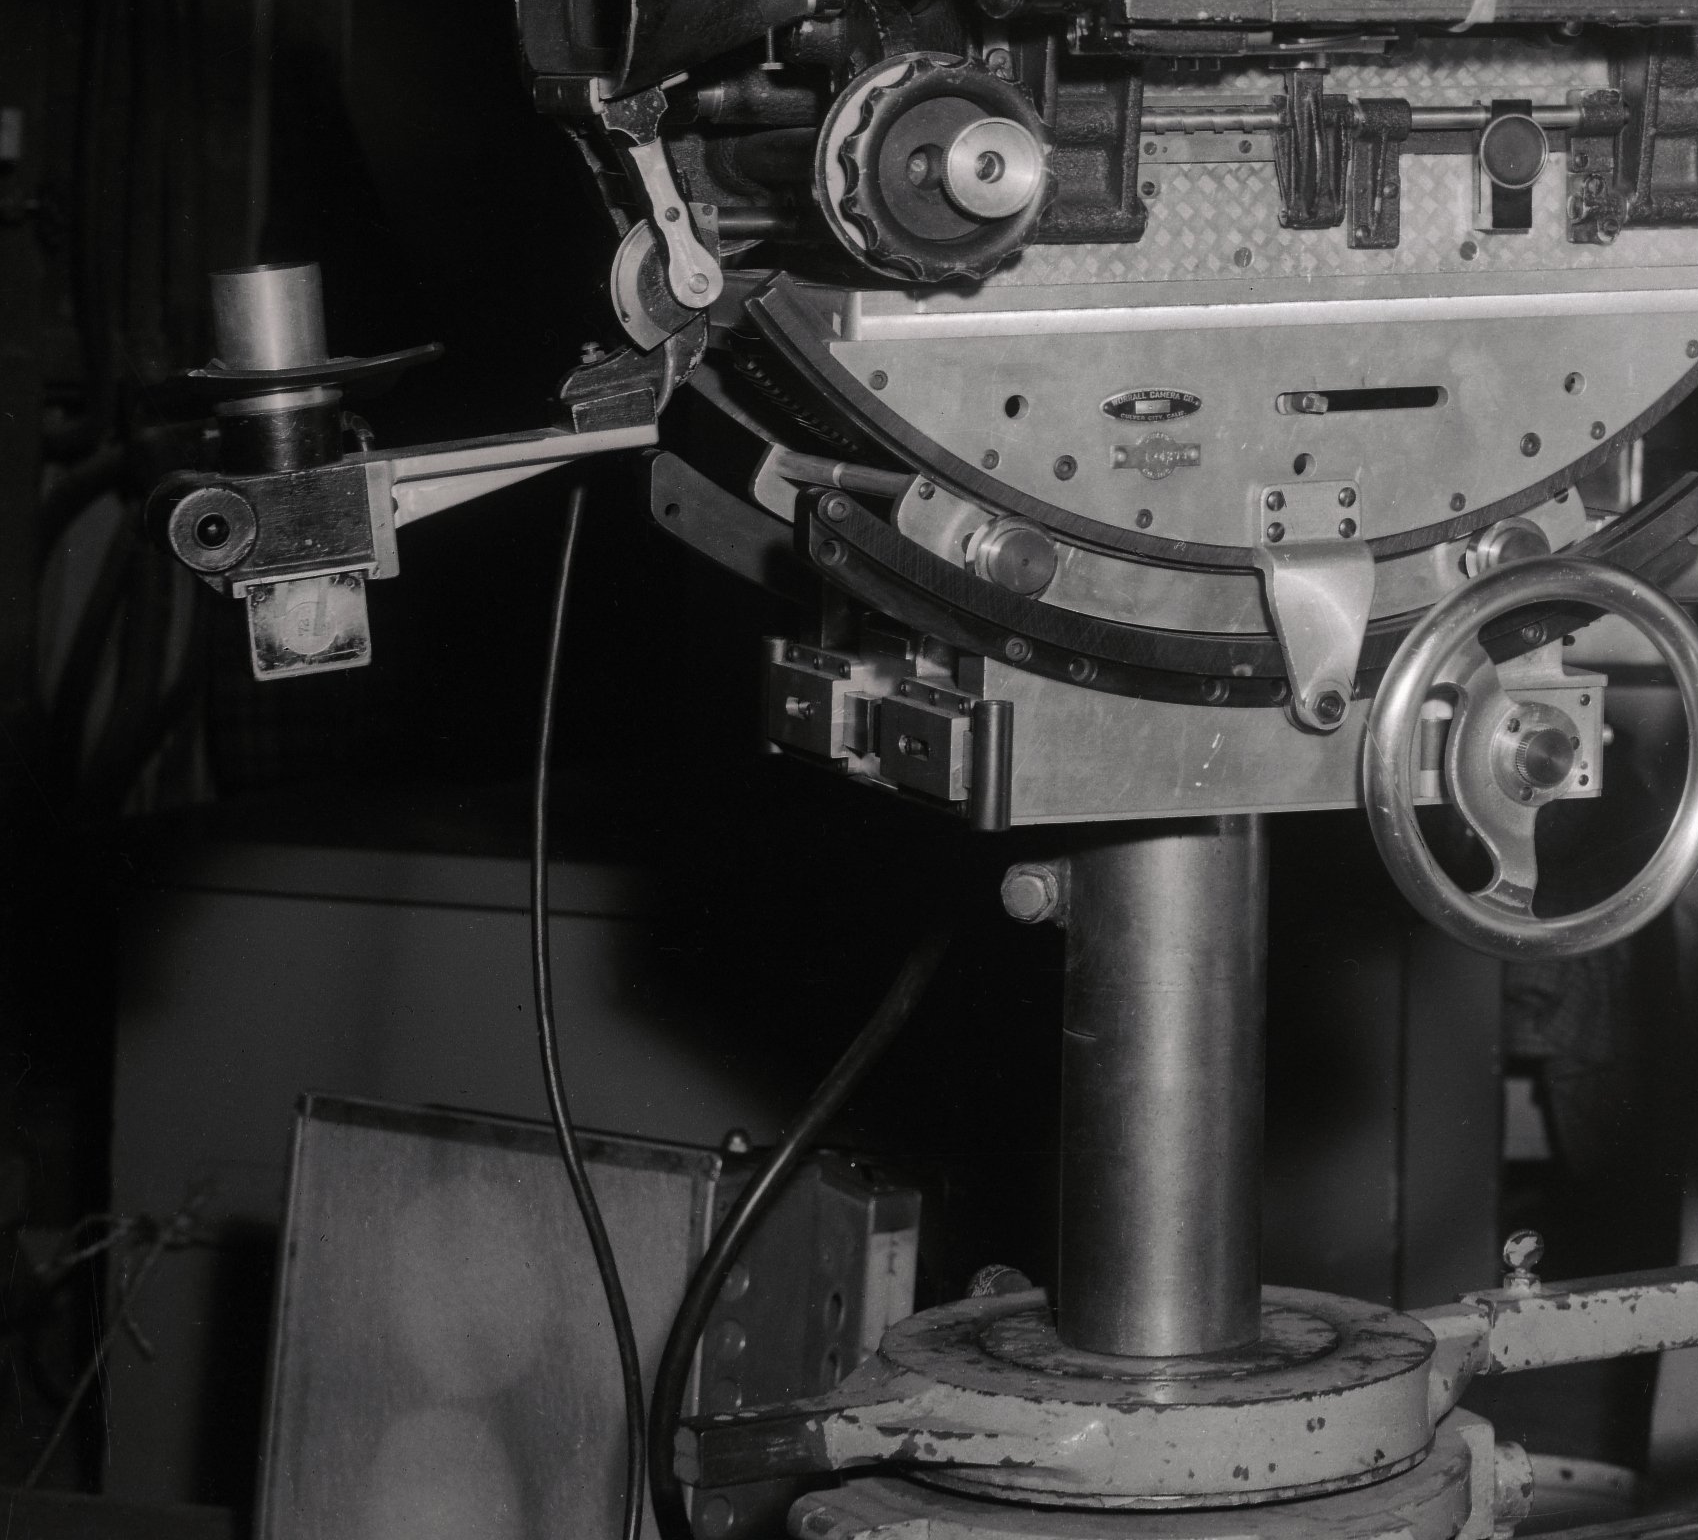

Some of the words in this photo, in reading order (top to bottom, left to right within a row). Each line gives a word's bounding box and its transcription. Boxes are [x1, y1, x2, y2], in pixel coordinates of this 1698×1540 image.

[1112, 392, 1147, 406] WORRALL
[1150, 391, 1180, 400] CAMERA
[1183, 394, 1195, 404] CO.
[1120, 413, 1146, 421] CULVER
[1166, 410, 1188, 418] CALIF.
